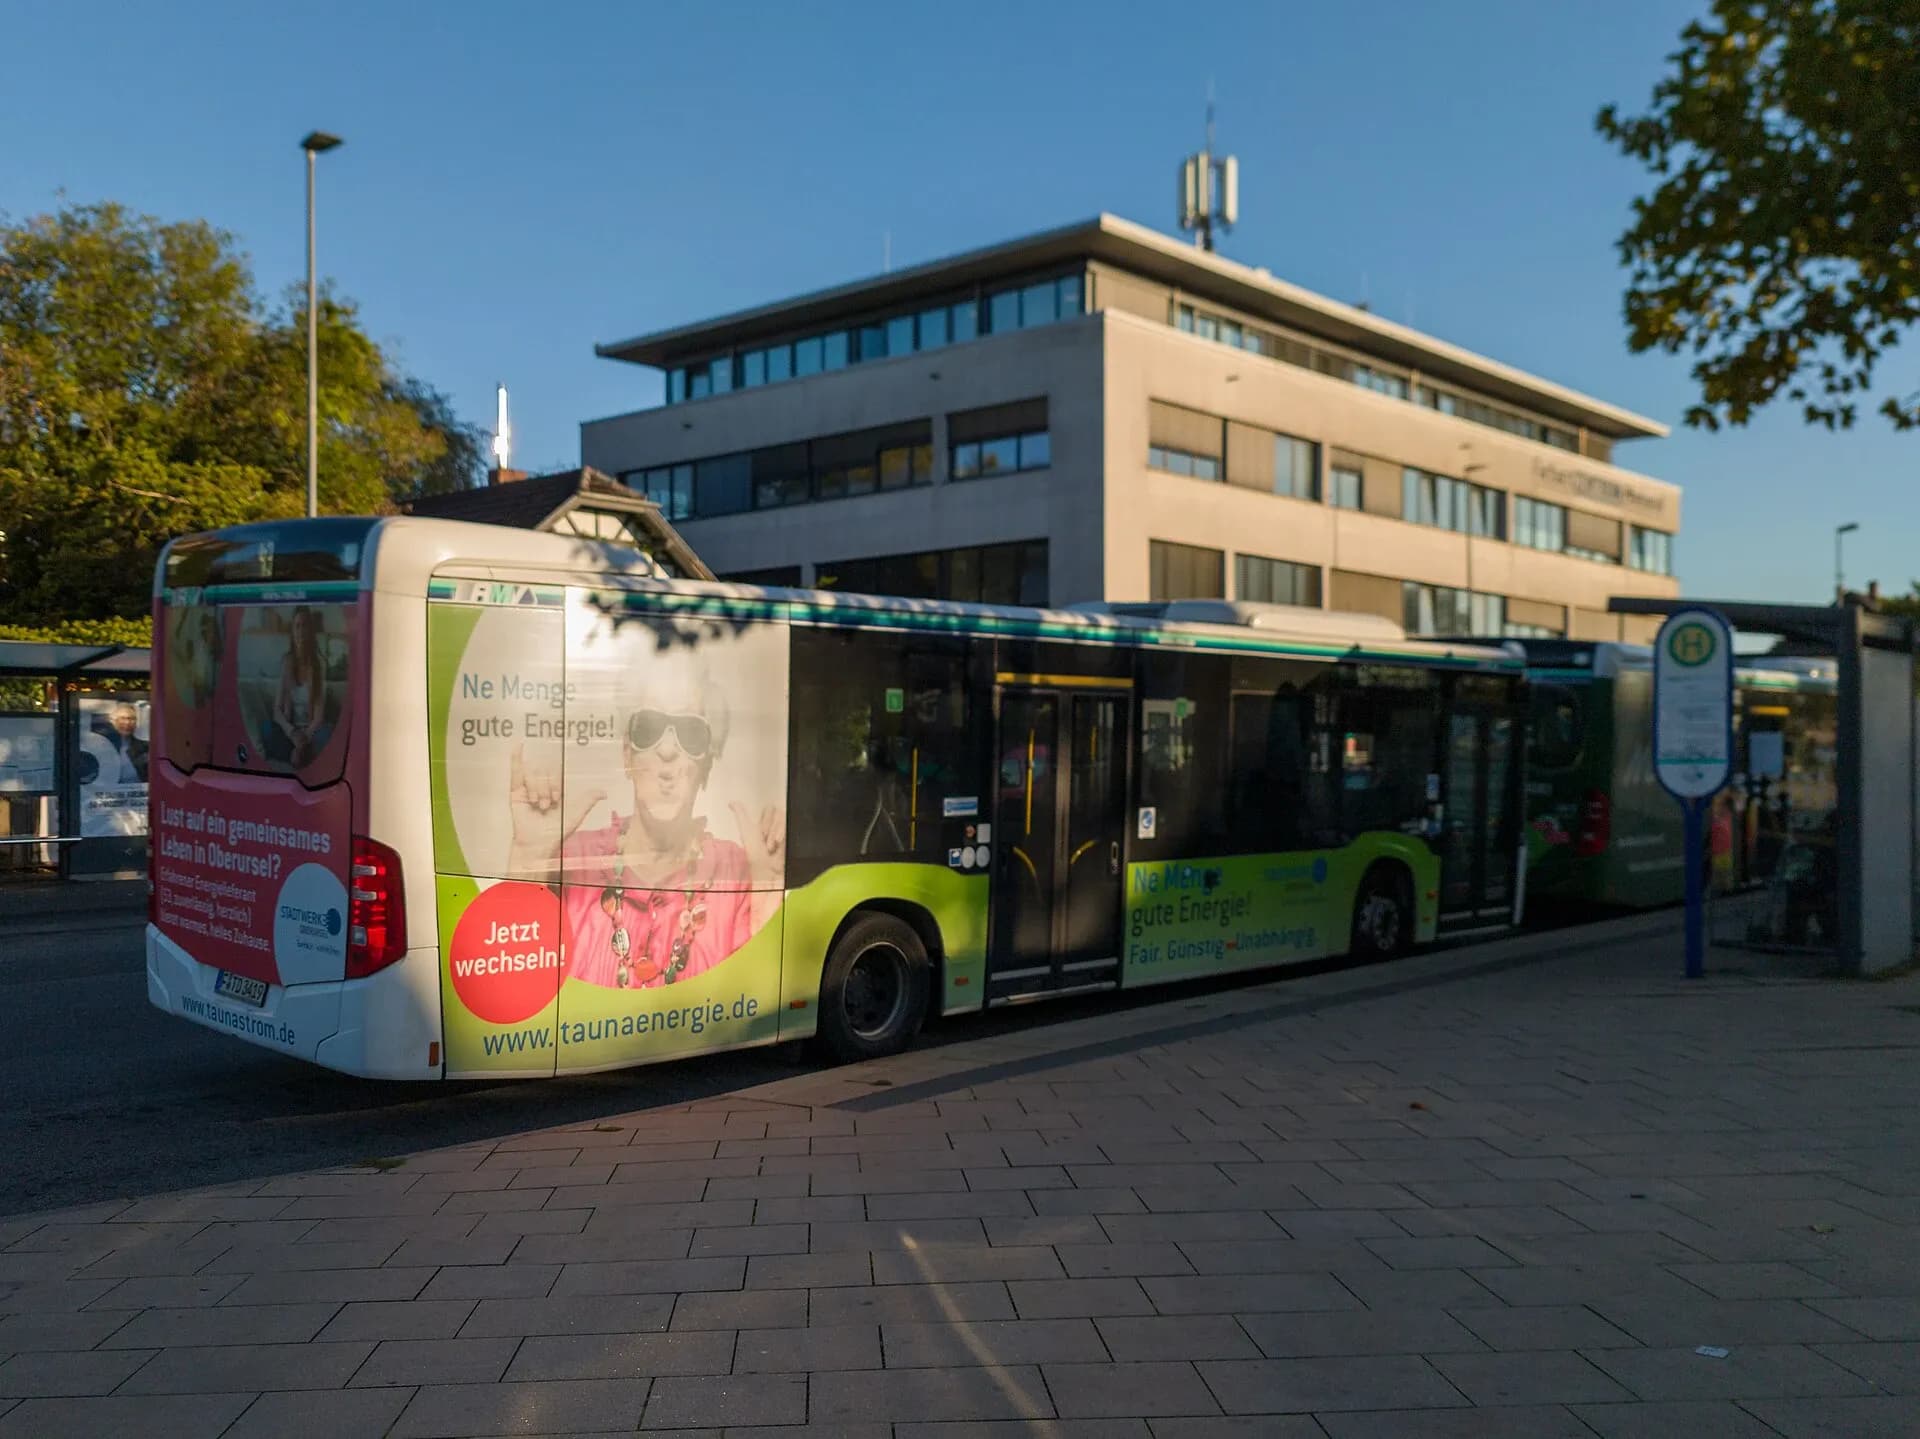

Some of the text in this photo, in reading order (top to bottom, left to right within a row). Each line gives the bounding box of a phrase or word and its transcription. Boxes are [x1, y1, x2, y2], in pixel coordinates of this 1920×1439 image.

[1682, 632, 1702, 657] H
[463, 672, 577, 709] Ne Menge
[461, 712, 616, 746] gute Energie!
[160, 802, 331, 853] Lust auf ein gemeinsames
[160, 834, 281, 879] Leben in Oberursel?
[1134, 867, 1160, 894] Ne
[484, 919, 540, 946] Jetzt
[1131, 891, 1251, 937] gute Energie!
[455, 942, 567, 978] wechseln!
[182, 994, 297, 1046] www.taunastrom.de
[482, 992, 760, 1057] www.taunaenergie.de
